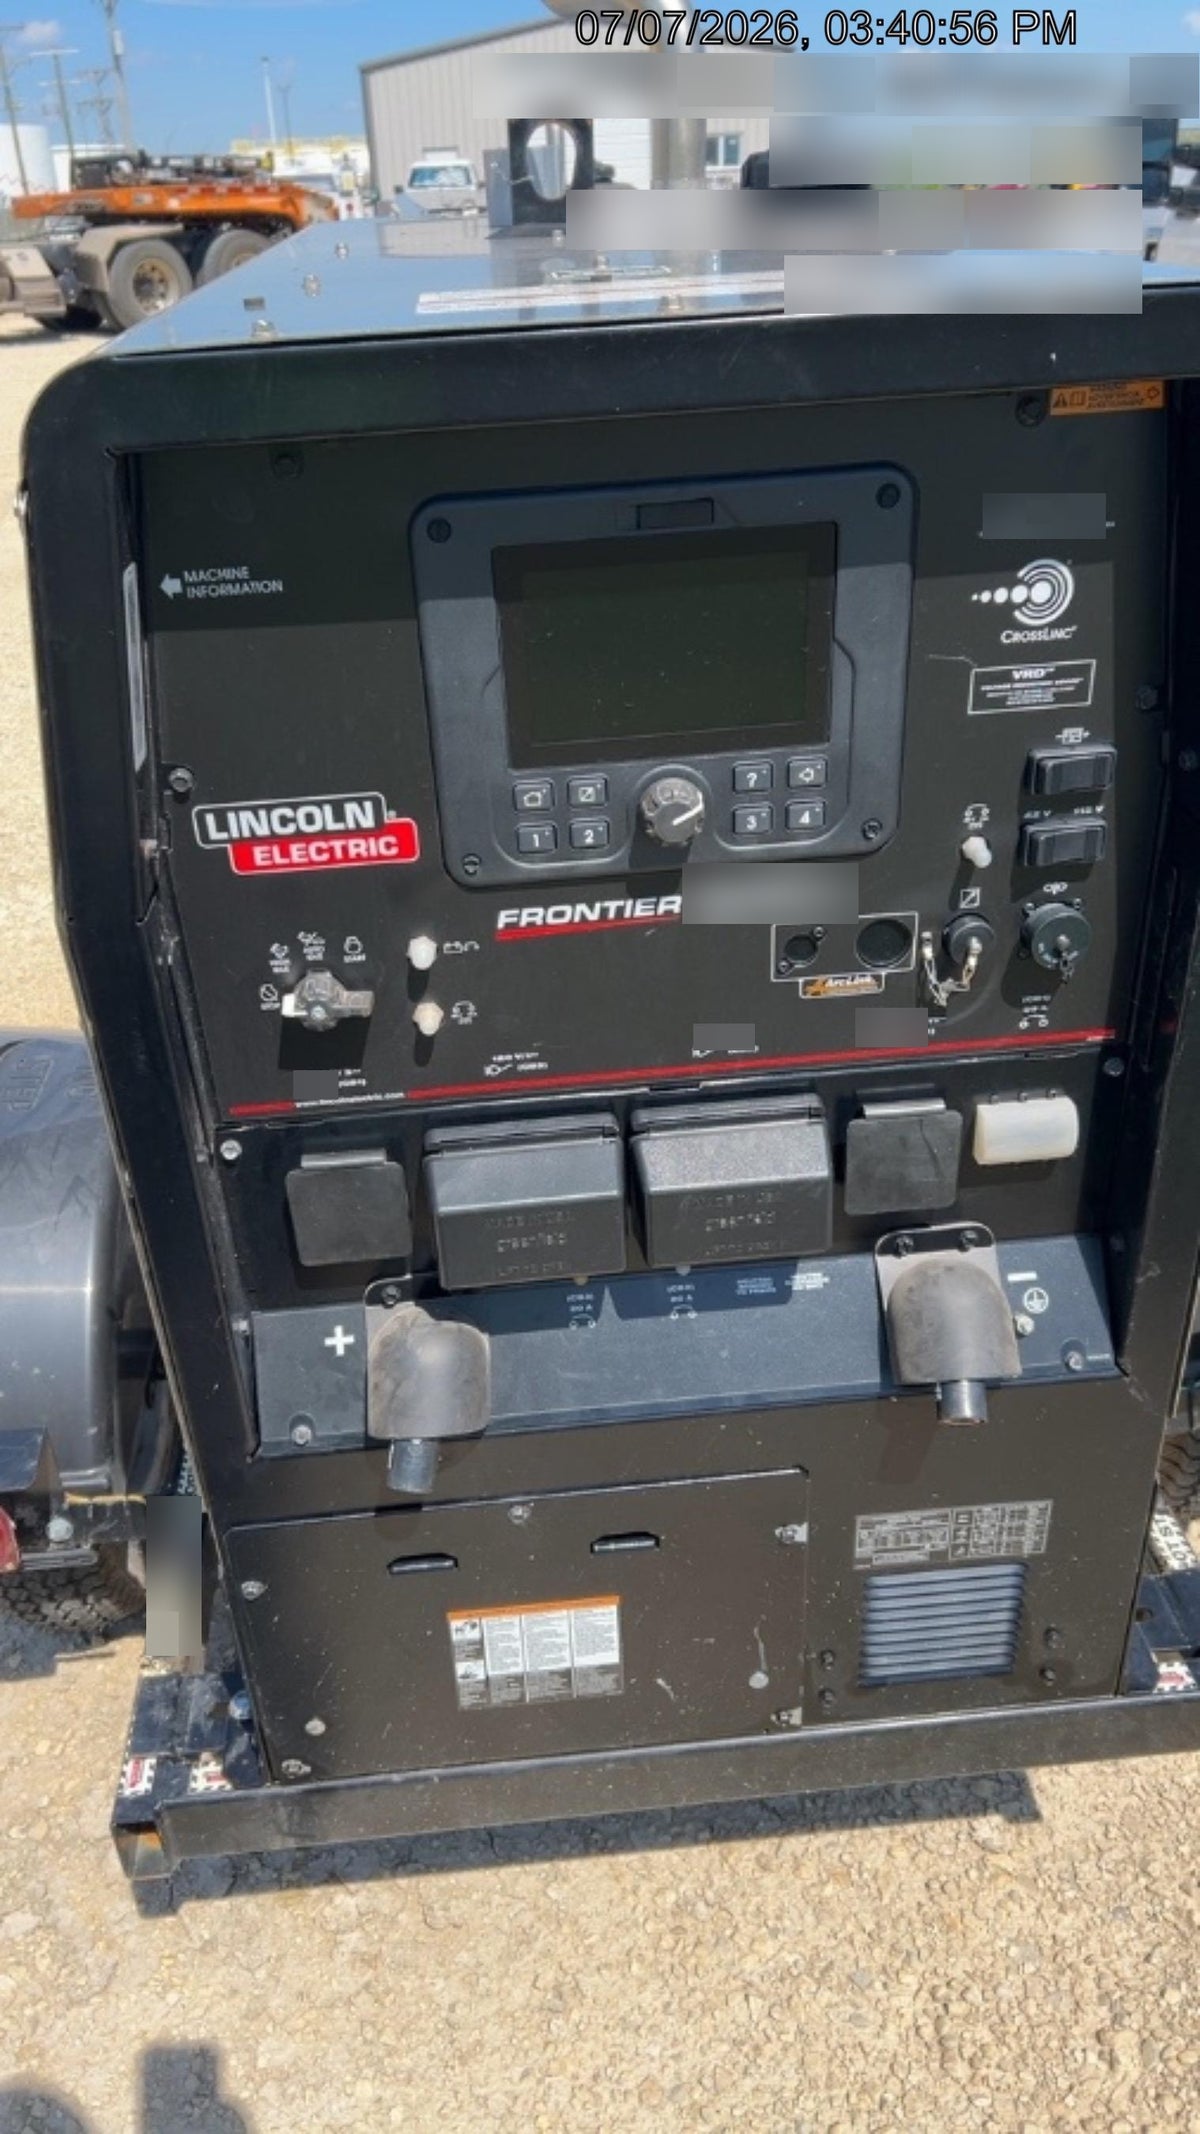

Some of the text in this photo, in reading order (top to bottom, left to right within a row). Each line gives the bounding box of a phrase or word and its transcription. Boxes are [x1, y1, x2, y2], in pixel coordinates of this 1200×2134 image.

[183, 566, 249, 582] MACHINE
[186, 579, 283, 598] INFORMATION
[205, 800, 376, 840] LINCOLN
[746, 815, 758, 830] 3
[798, 810, 810, 825] 4
[532, 834, 540, 848] 1
[583, 829, 594, 844] 2
[252, 834, 399, 866] ELECTRIC
[497, 895, 682, 930] FRONTIER
